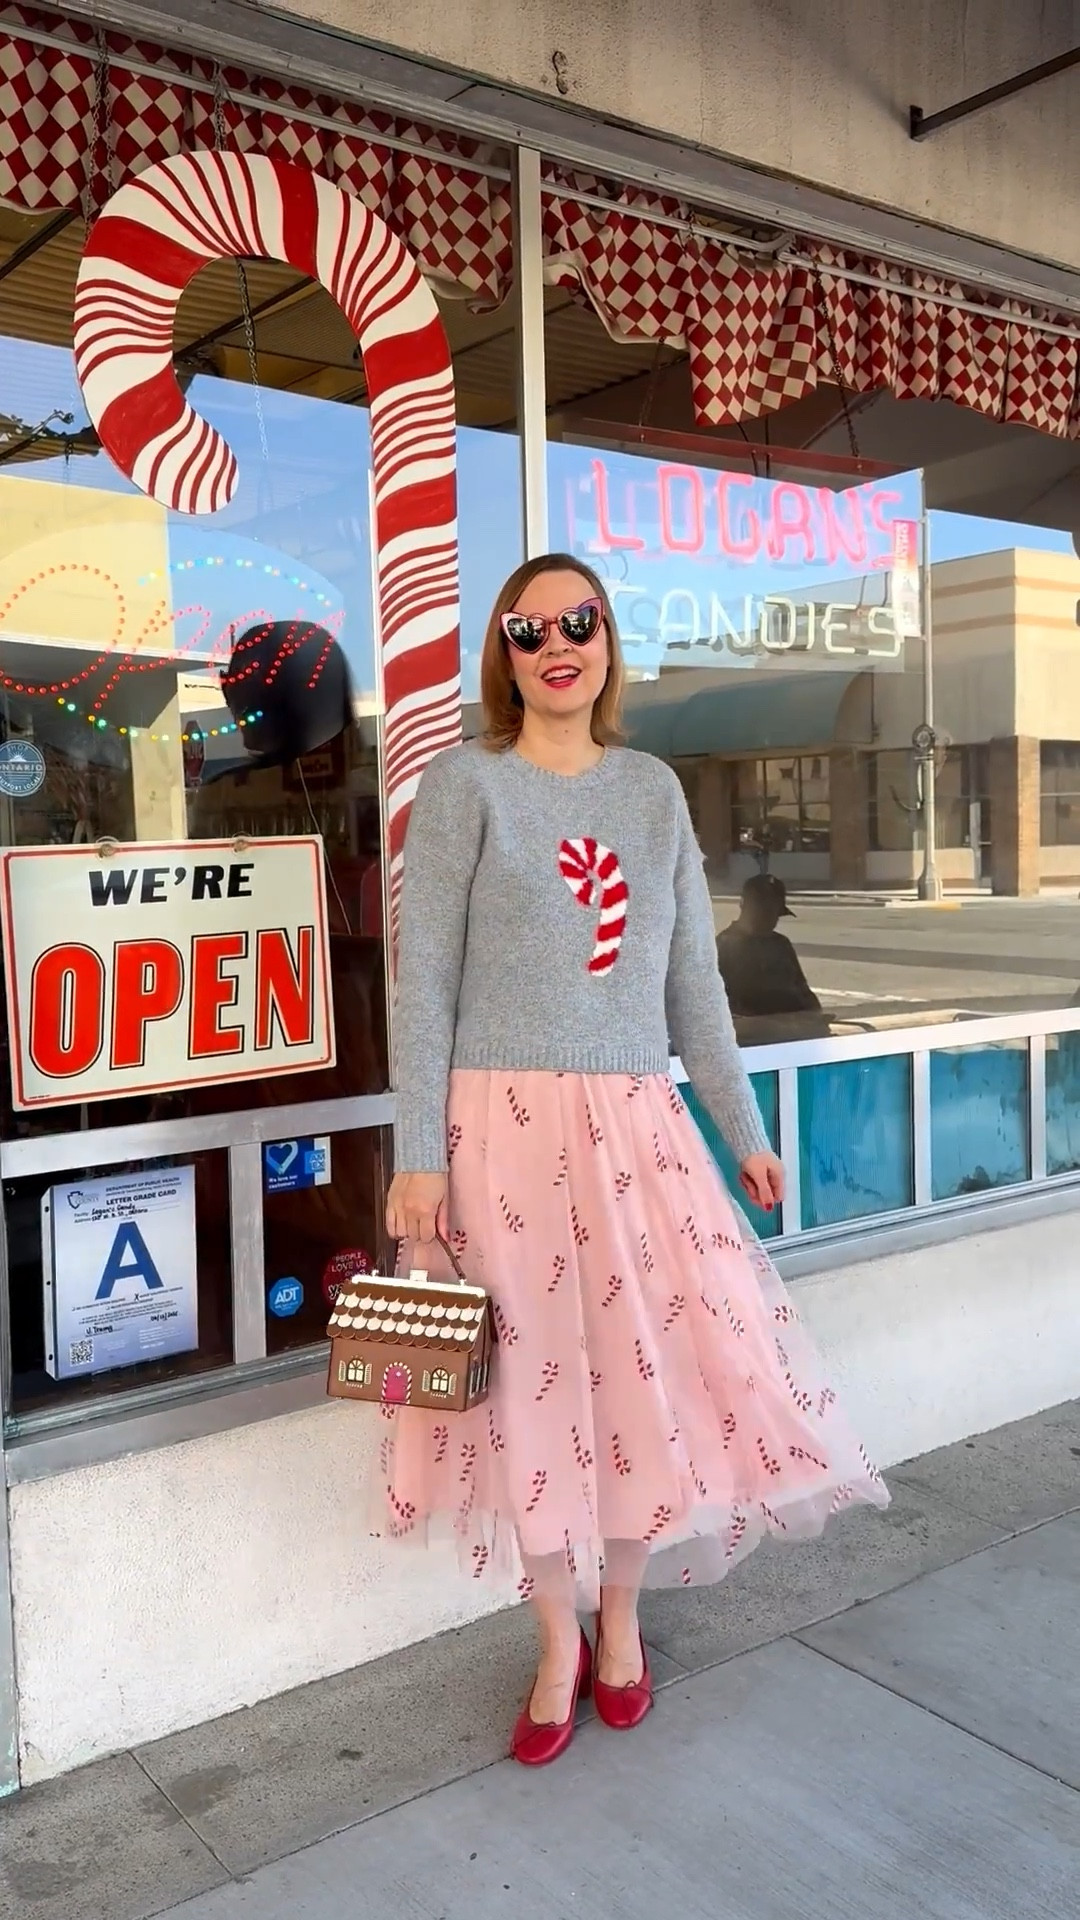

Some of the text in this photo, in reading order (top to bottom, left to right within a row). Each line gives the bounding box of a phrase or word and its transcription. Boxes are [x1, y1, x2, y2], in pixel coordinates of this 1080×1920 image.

[591, 457, 903, 568] LOGAN'S
[0, 764, 43, 772] NTARIO
[89, 863, 254, 906] WE'RE
[29, 926, 314, 1079] OPEN
[269, 1181, 296, 1189] customers
[106, 1195, 132, 1206] LETTER
[133, 1192, 157, 1201] GRADE
[158, 1188, 177, 1197] CARD
[95, 1221, 164, 1300] A
[332, 1258, 367, 1273] LOVE US
[275, 1286, 299, 1304] ADT
